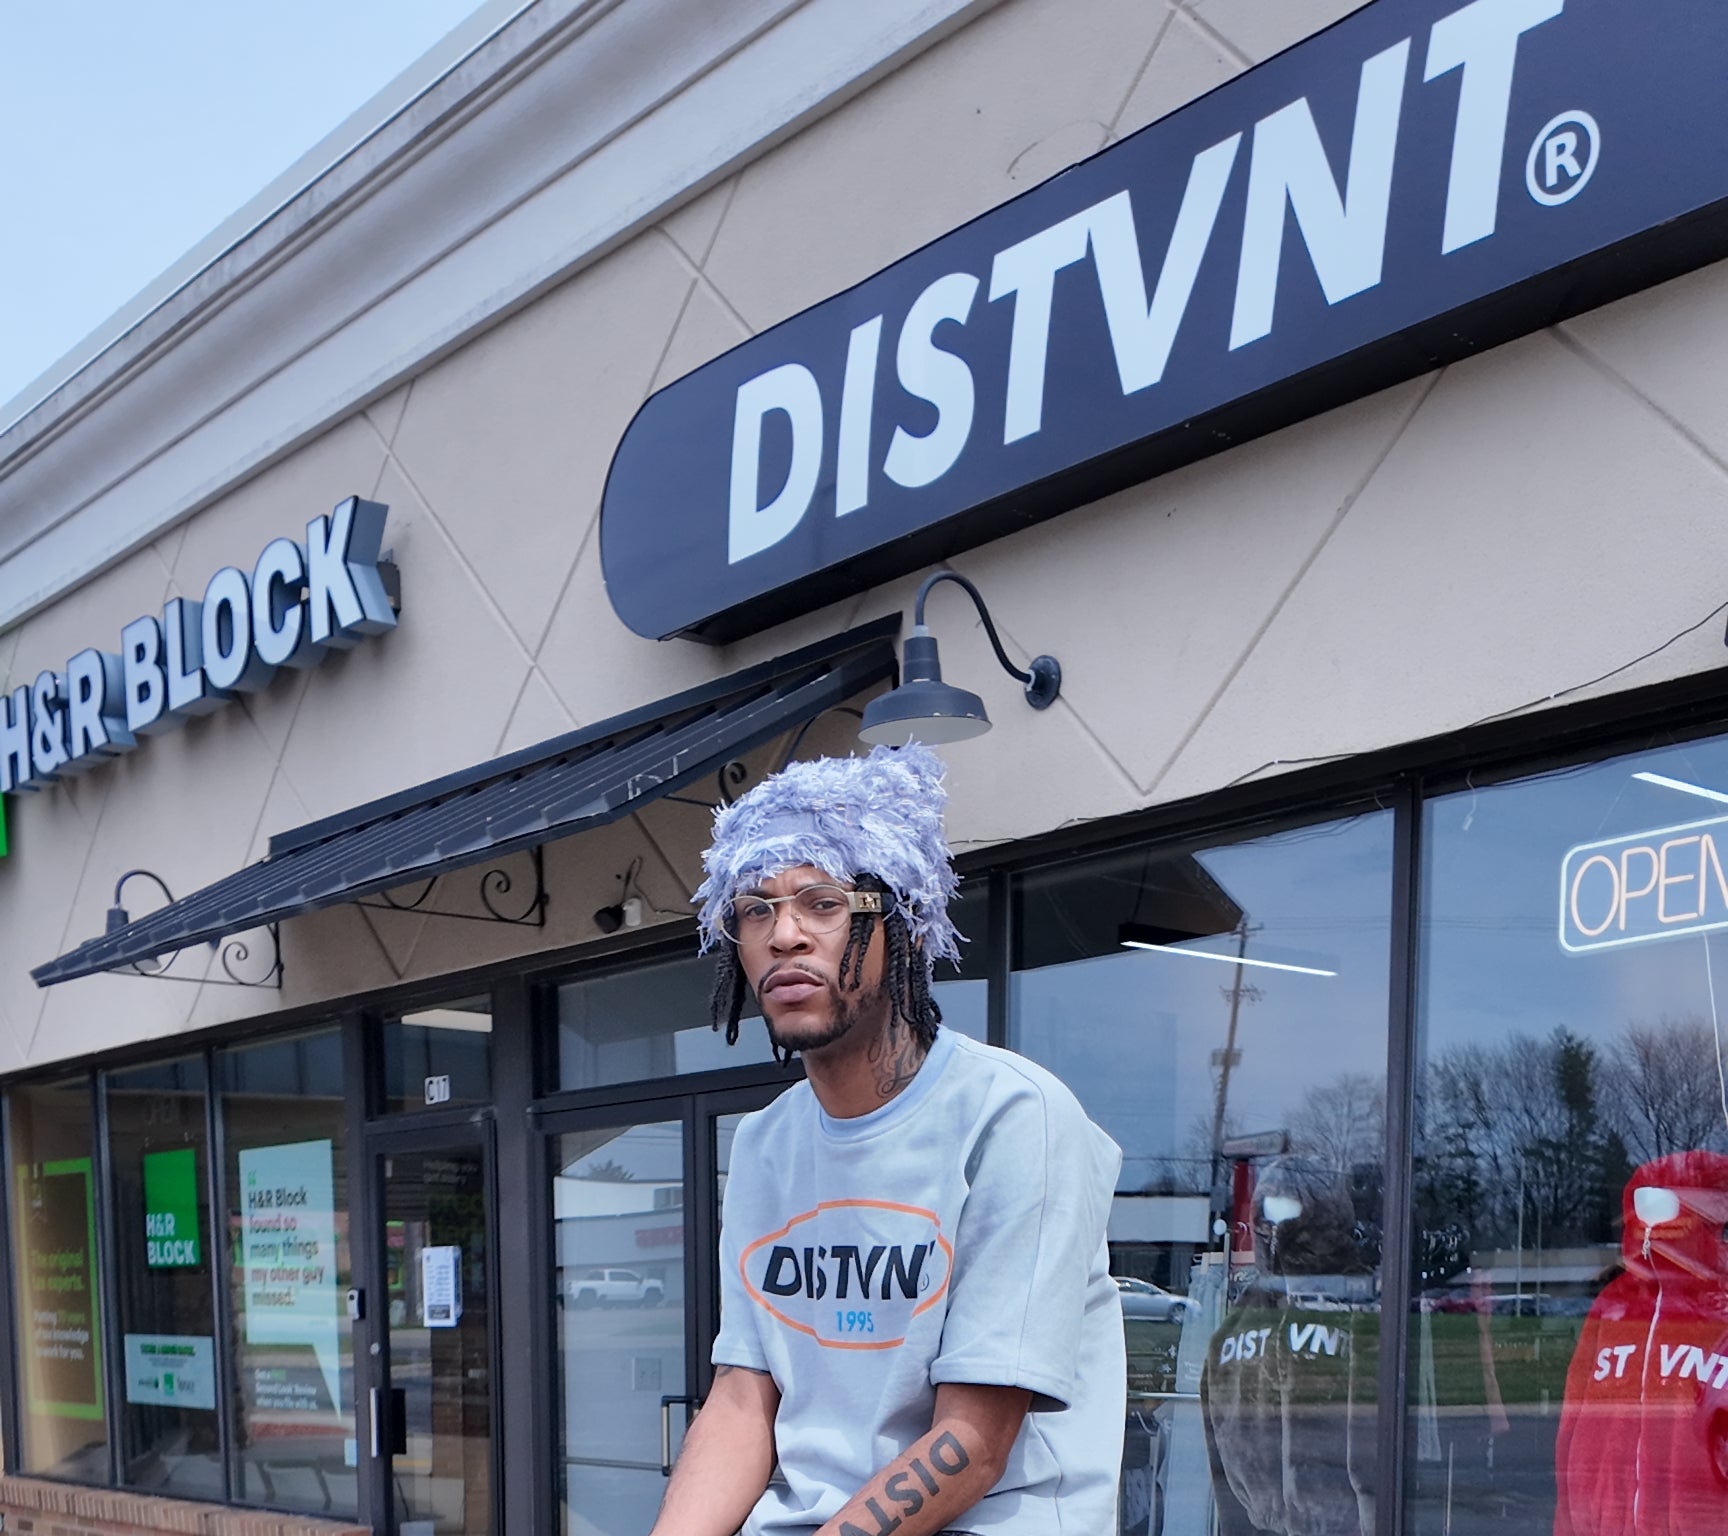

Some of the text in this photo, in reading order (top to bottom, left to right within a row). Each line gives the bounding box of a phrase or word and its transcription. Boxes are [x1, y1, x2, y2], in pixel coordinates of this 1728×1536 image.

[0, 495, 367, 793] H&R BLOCK
[1570, 834, 1728, 937] OPEN
[248, 1186, 307, 1208] H&R Block
[146, 1213, 175, 1237] H&R
[250, 1213, 297, 1233] found so
[147, 1240, 195, 1265] BLOCK
[251, 1236, 319, 1262] many things
[270, 1263, 300, 1282] other
[302, 1267, 325, 1286] guy
[836, 1311, 874, 1333] 1995
[1219, 1327, 1272, 1365] DIST
[1593, 1344, 1637, 1381] ST
